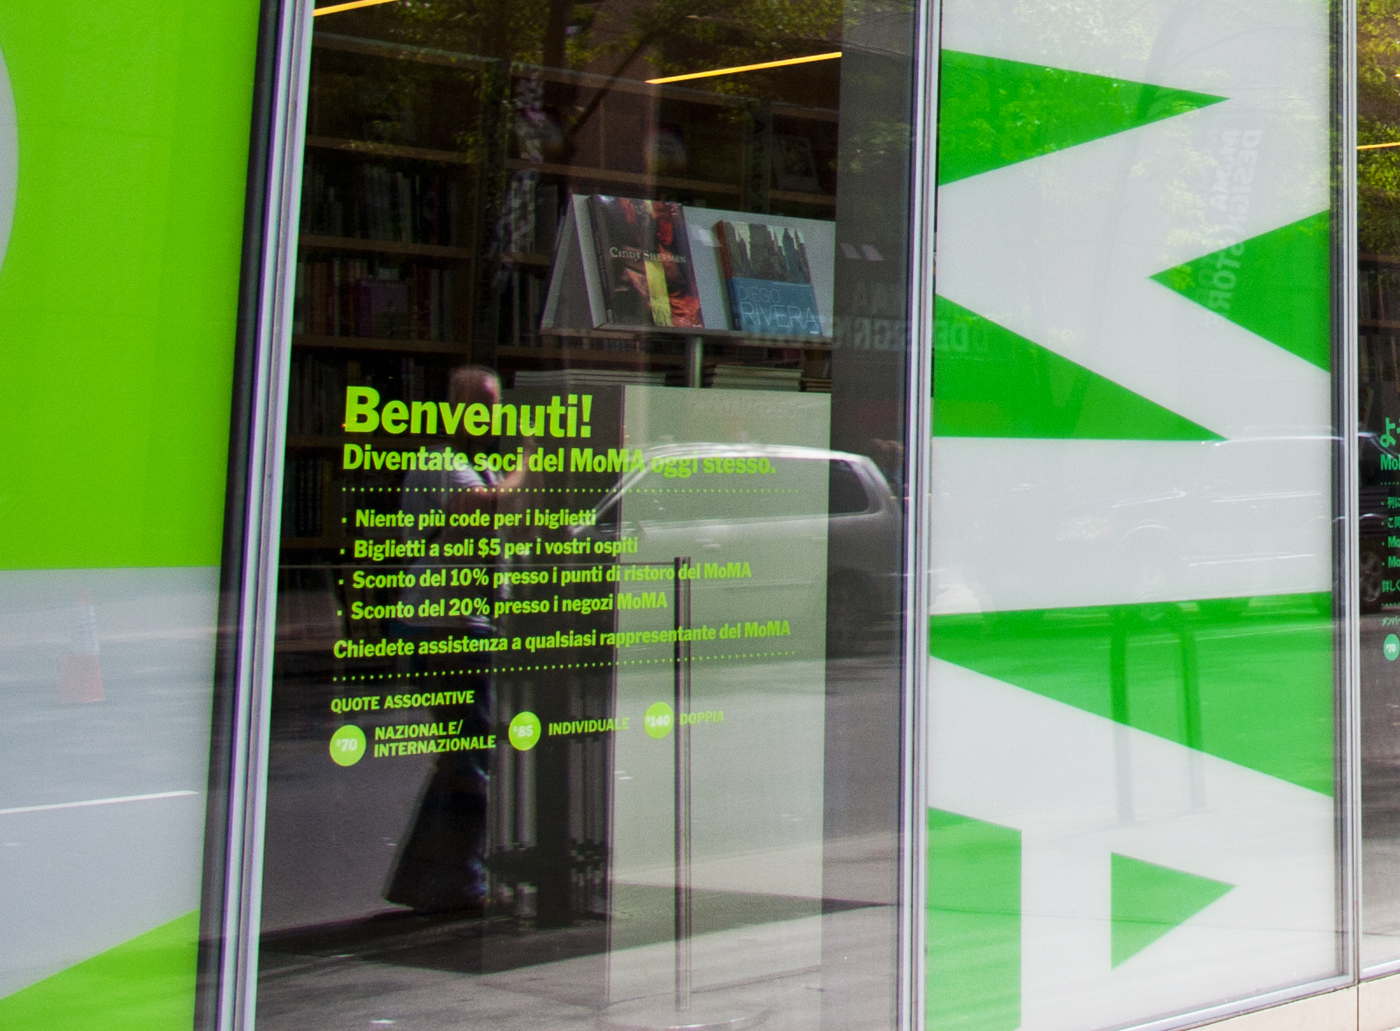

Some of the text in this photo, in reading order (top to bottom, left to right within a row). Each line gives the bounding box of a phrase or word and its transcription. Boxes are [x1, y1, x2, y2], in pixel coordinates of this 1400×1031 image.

[736, 286, 783, 304] DIEGO
[739, 301, 821, 327] RIVERA
[344, 386, 592, 437] Benvenuti!
[344, 444, 775, 478] Diventate soci del MoMA oggi stesso.
[356, 509, 595, 530] Niente più code per i biglietti
[355, 537, 637, 559] Biglietti a soli $5 per i vostri ospiti
[353, 562, 751, 588] Sconto del 10% presso i punti di ristoro del MoMA
[352, 592, 667, 619] Sconto del 20% presso i negozi MoMA
[334, 621, 790, 658] Chiedete assistenza a qualsiasi rappresentante del MoMA
[331, 690, 474, 713] QUOTE ASSOCIATIVE
[375, 720, 464, 739] NAZIONALE/
[512, 724, 535, 738] $85
[549, 719, 627, 735] INDIVIDUALE
[643, 713, 672, 728] $140
[335, 736, 359, 753] $70
[375, 734, 496, 756] INTERNAZIONALE
